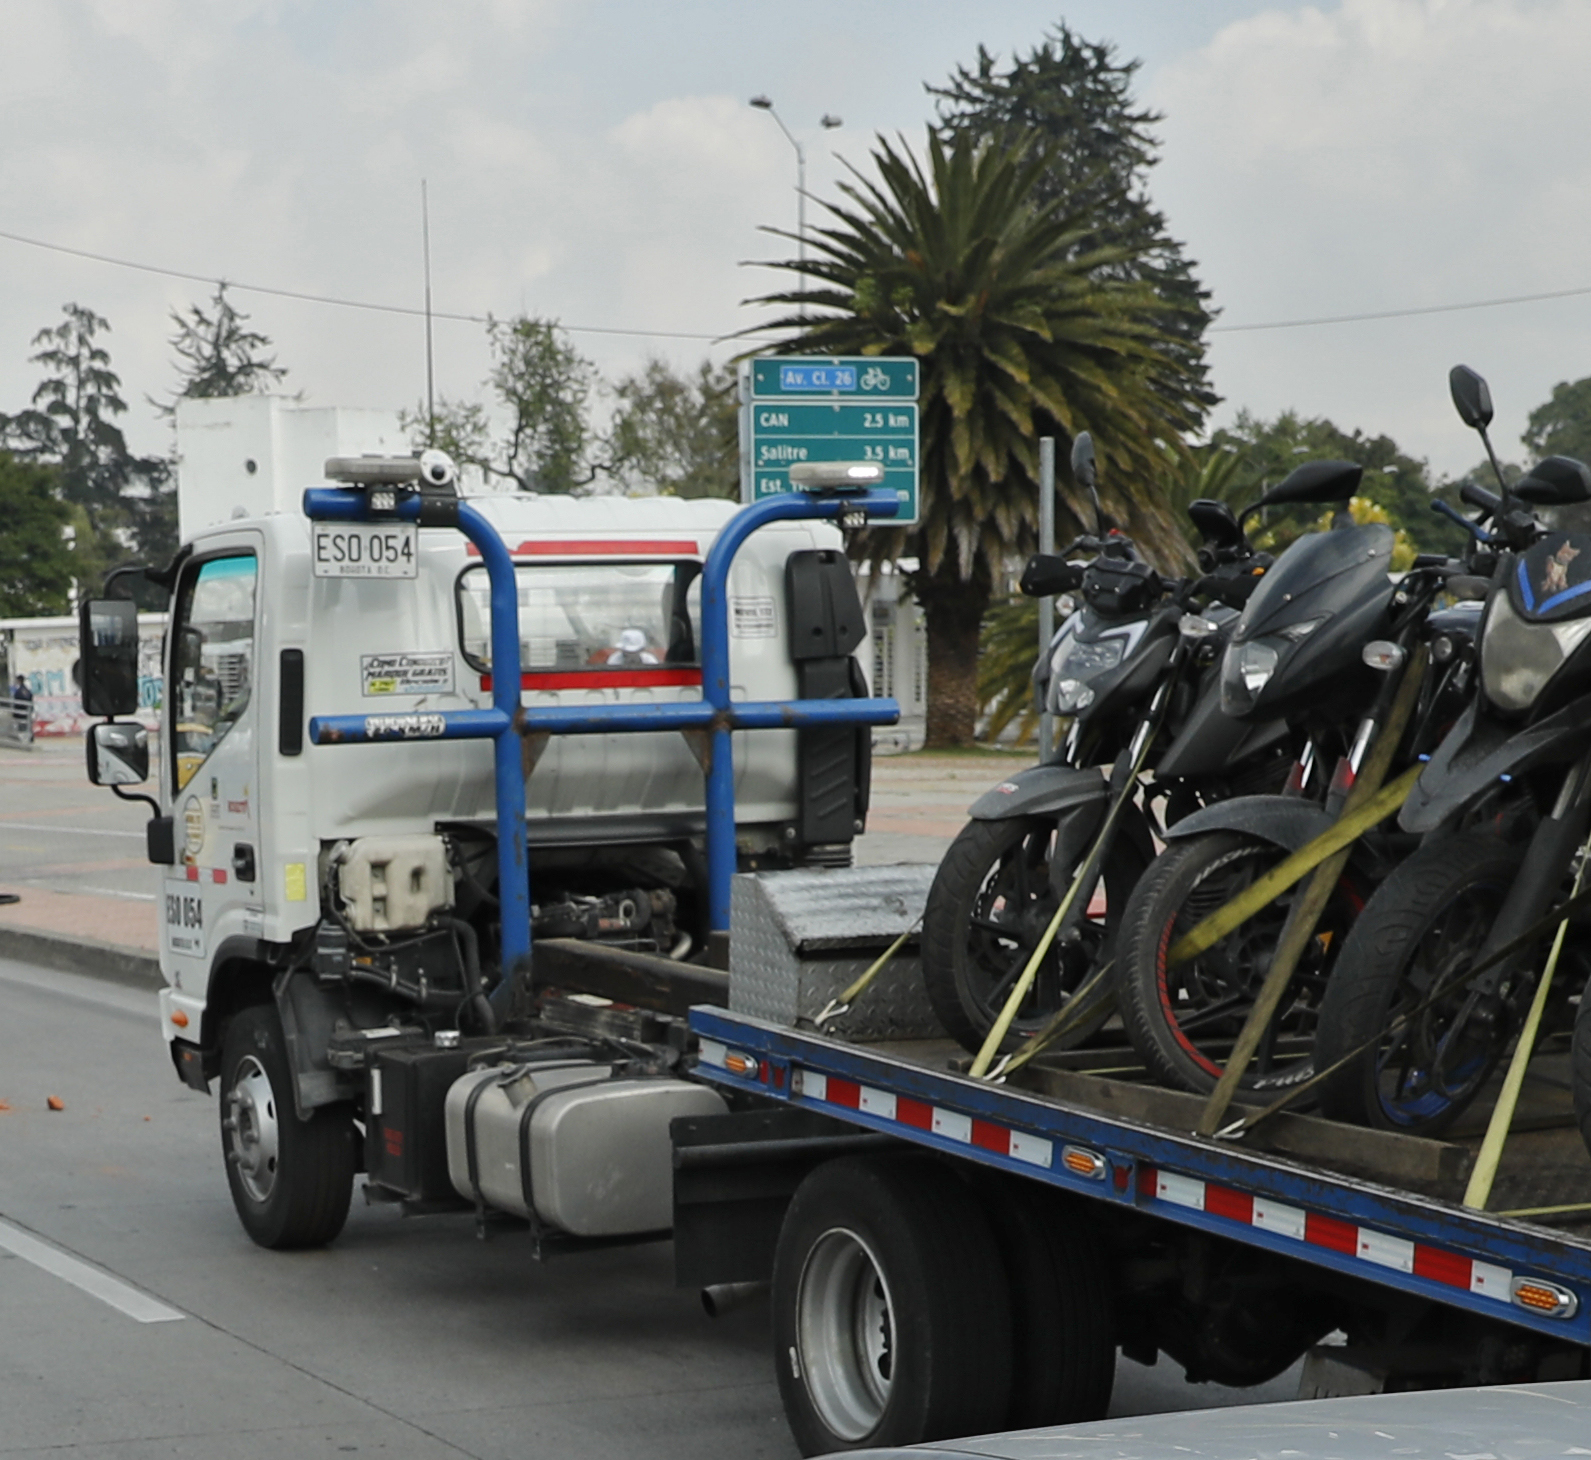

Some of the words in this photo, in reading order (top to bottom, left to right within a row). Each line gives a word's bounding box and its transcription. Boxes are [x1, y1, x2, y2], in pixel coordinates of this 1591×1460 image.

[785, 371, 807, 386] Av.
[835, 371, 853, 386] 26
[760, 413, 789, 428] CAN
[863, 413, 884, 428] 2.5
[888, 413, 910, 428] km
[760, 445, 808, 461] Salitre
[863, 445, 884, 461] 3.5
[888, 445, 910, 461] km
[760, 478, 786, 493] Est.
[316, 533, 362, 564] ESO
[369, 534, 415, 565] 054
